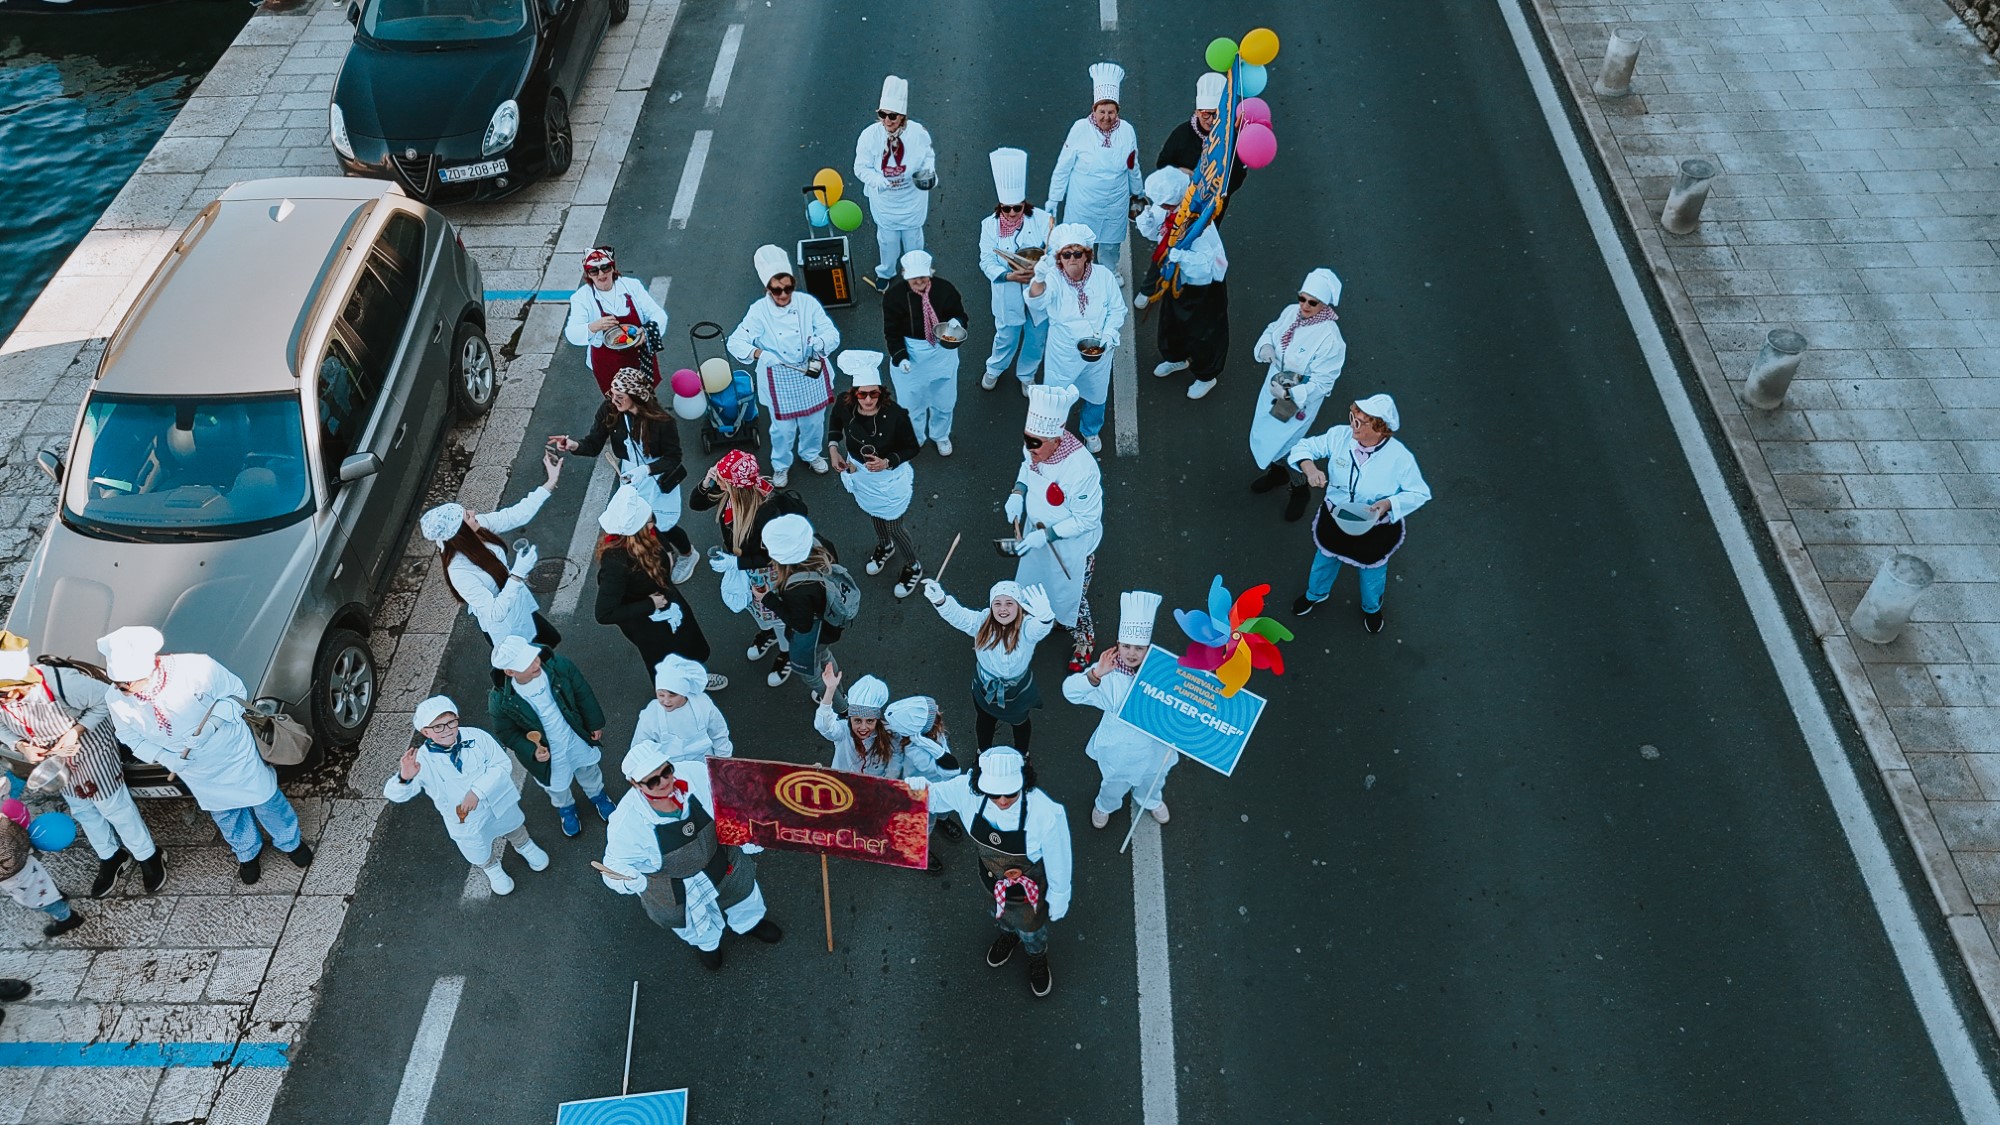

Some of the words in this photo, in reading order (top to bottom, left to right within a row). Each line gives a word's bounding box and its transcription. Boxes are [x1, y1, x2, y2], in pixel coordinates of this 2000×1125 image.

[447, 169, 461, 180] ZD
[467, 161, 507, 178] 208-PB
[1173, 685, 1217, 711] PUNTAMIKA
[1183, 681, 1215, 701] UDRUGA
[748, 818, 889, 856] MasterChef
